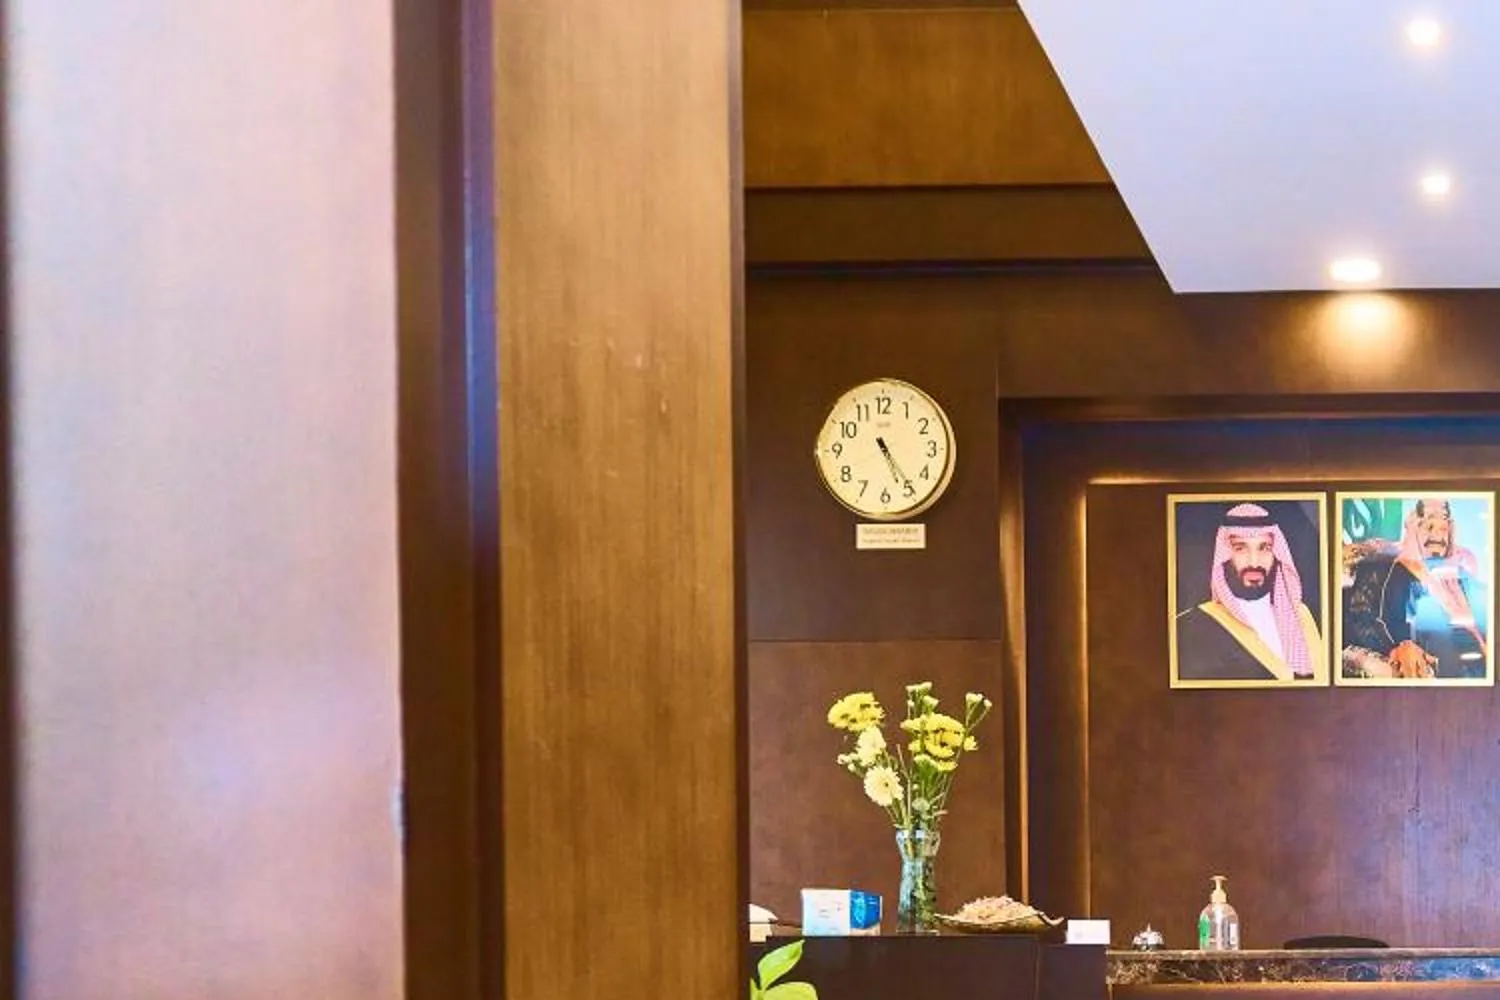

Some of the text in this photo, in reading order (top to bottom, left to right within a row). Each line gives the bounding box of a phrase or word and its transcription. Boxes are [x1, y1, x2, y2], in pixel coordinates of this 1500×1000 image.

[856, 403, 870, 422] 11
[875, 397, 892, 415] 12
[902, 401, 909, 420] 1
[840, 421, 857, 439] 10
[917, 417, 929, 435] 2
[831, 443, 843, 459] 9
[927, 440, 937, 458] 3
[840, 465, 851, 483] 8
[919, 464, 929, 481] 4
[858, 480, 869, 498] 7
[880, 488, 891, 504] 6
[903, 480, 915, 497] 5
